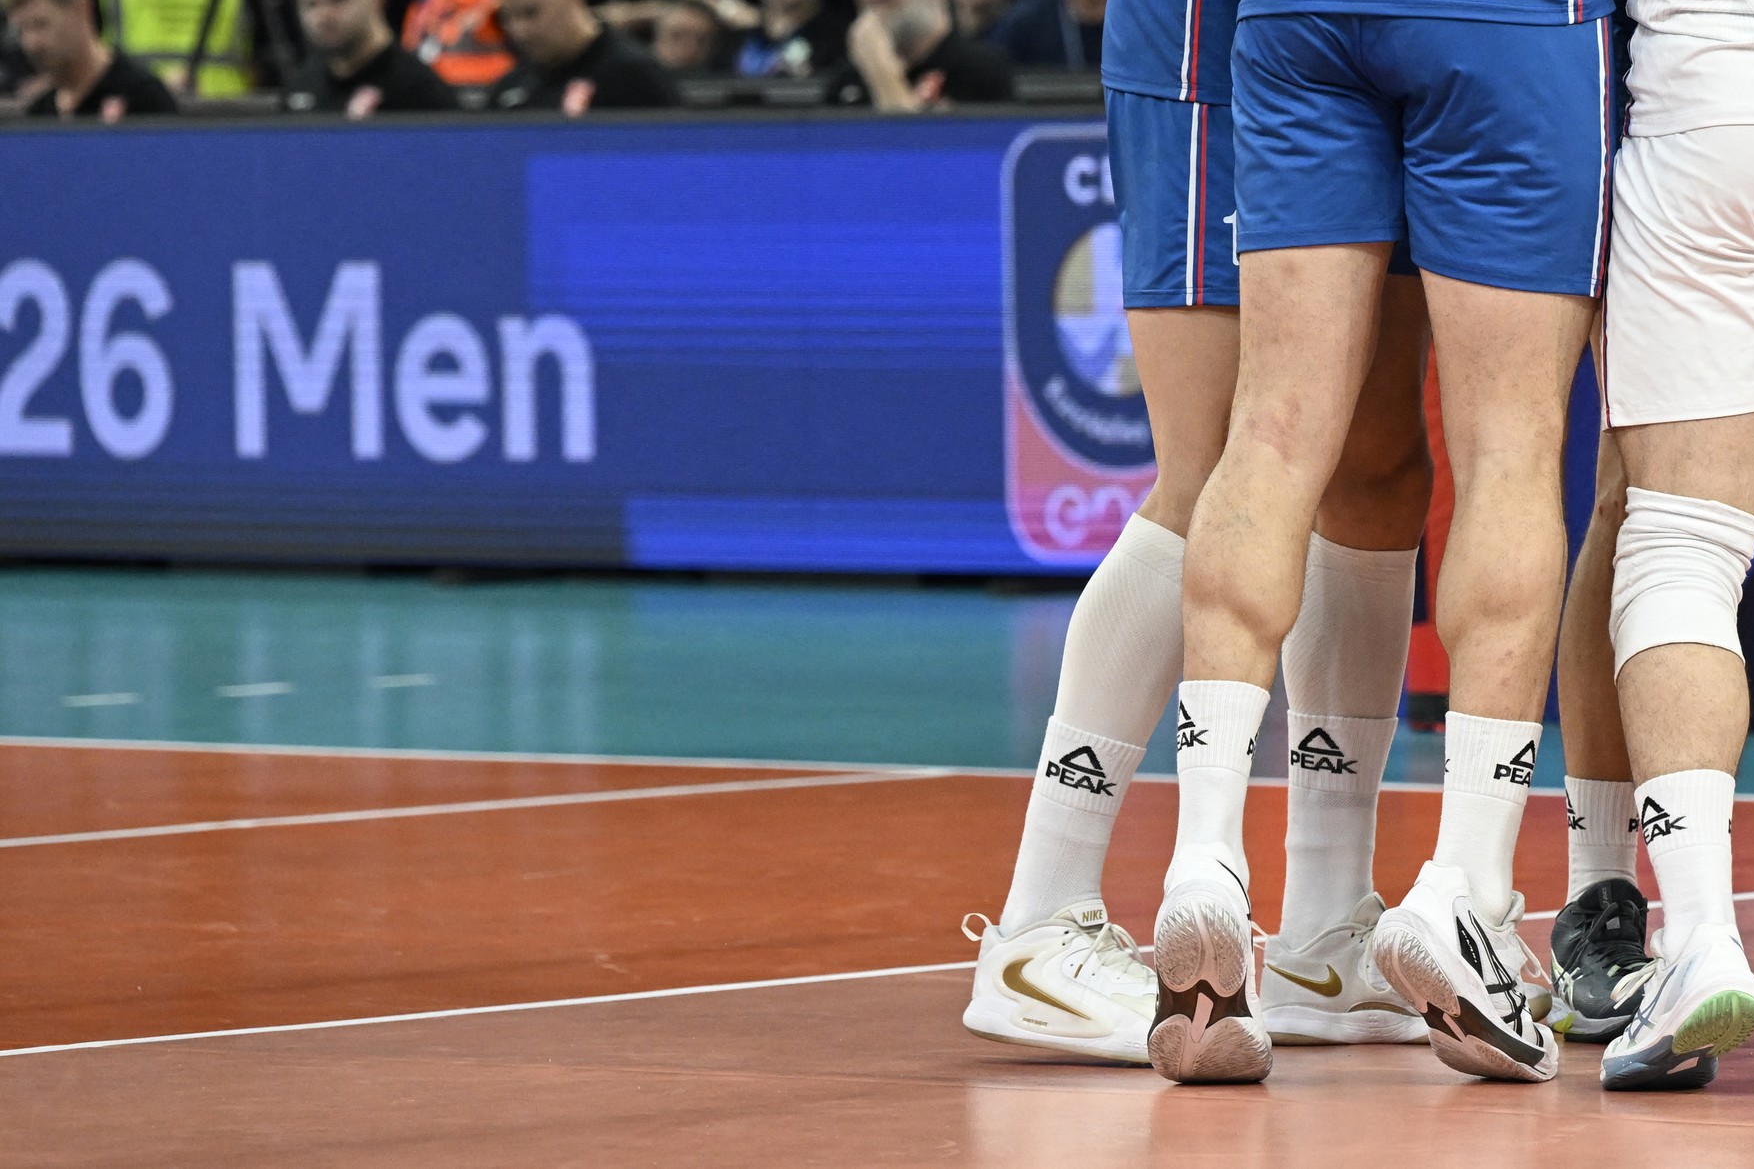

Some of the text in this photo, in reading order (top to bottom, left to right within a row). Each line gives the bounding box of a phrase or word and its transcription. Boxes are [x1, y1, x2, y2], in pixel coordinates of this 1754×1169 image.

[0, 258, 598, 464] 26 Men
[1290, 749, 1358, 775] PEAK
[1045, 760, 1118, 797] PEAK
[1082, 909, 1103, 922] NIKE
